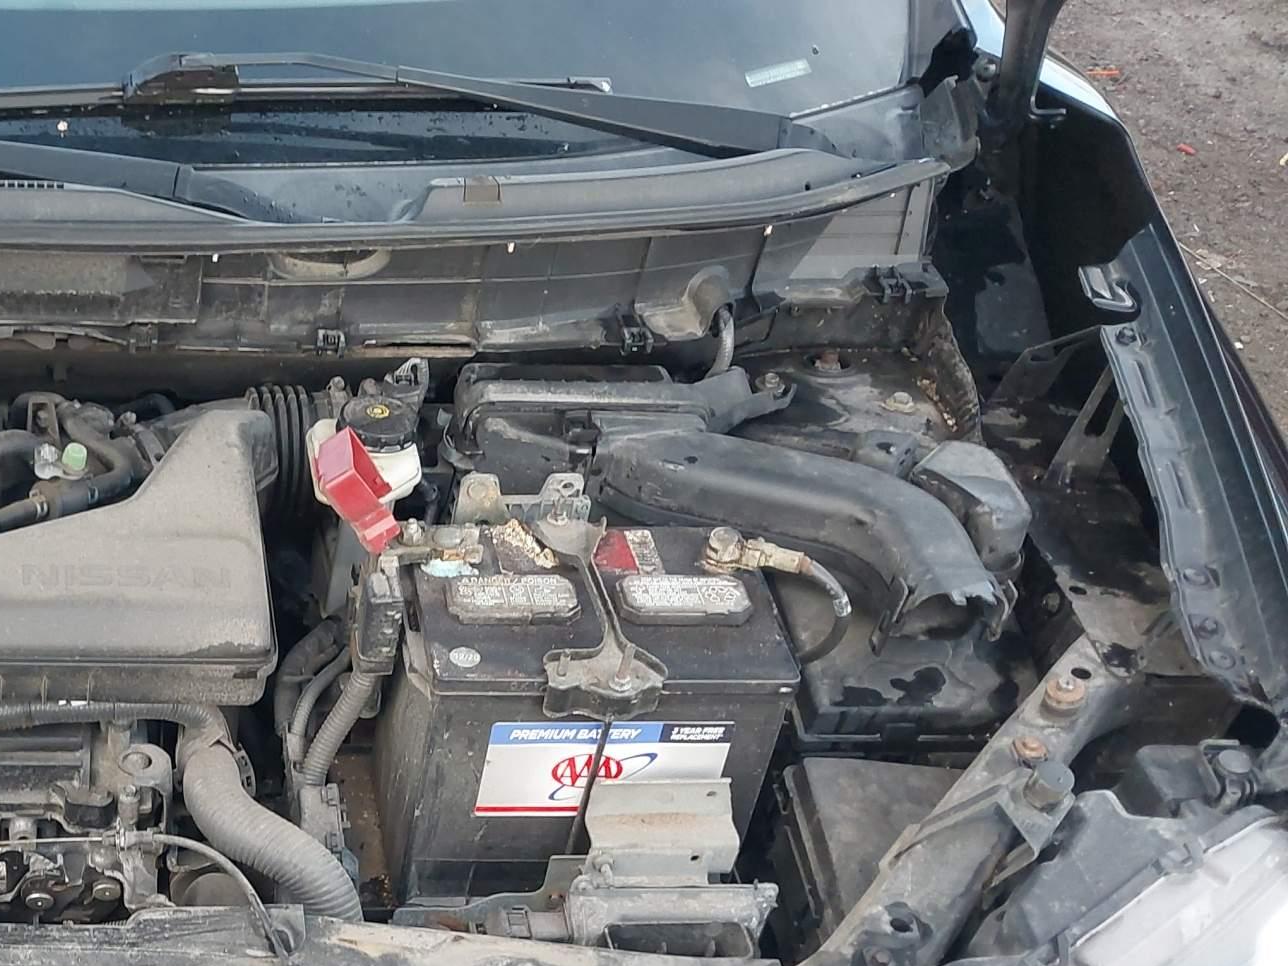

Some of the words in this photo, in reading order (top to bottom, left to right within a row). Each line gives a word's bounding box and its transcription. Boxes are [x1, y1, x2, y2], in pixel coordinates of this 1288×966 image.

[21, 563, 232, 589] NISSAN
[509, 728, 576, 740] PREMIUM
[575, 728, 642, 740] BATERY
[679, 727, 702, 735] YEAR
[702, 727, 726, 735] FREE
